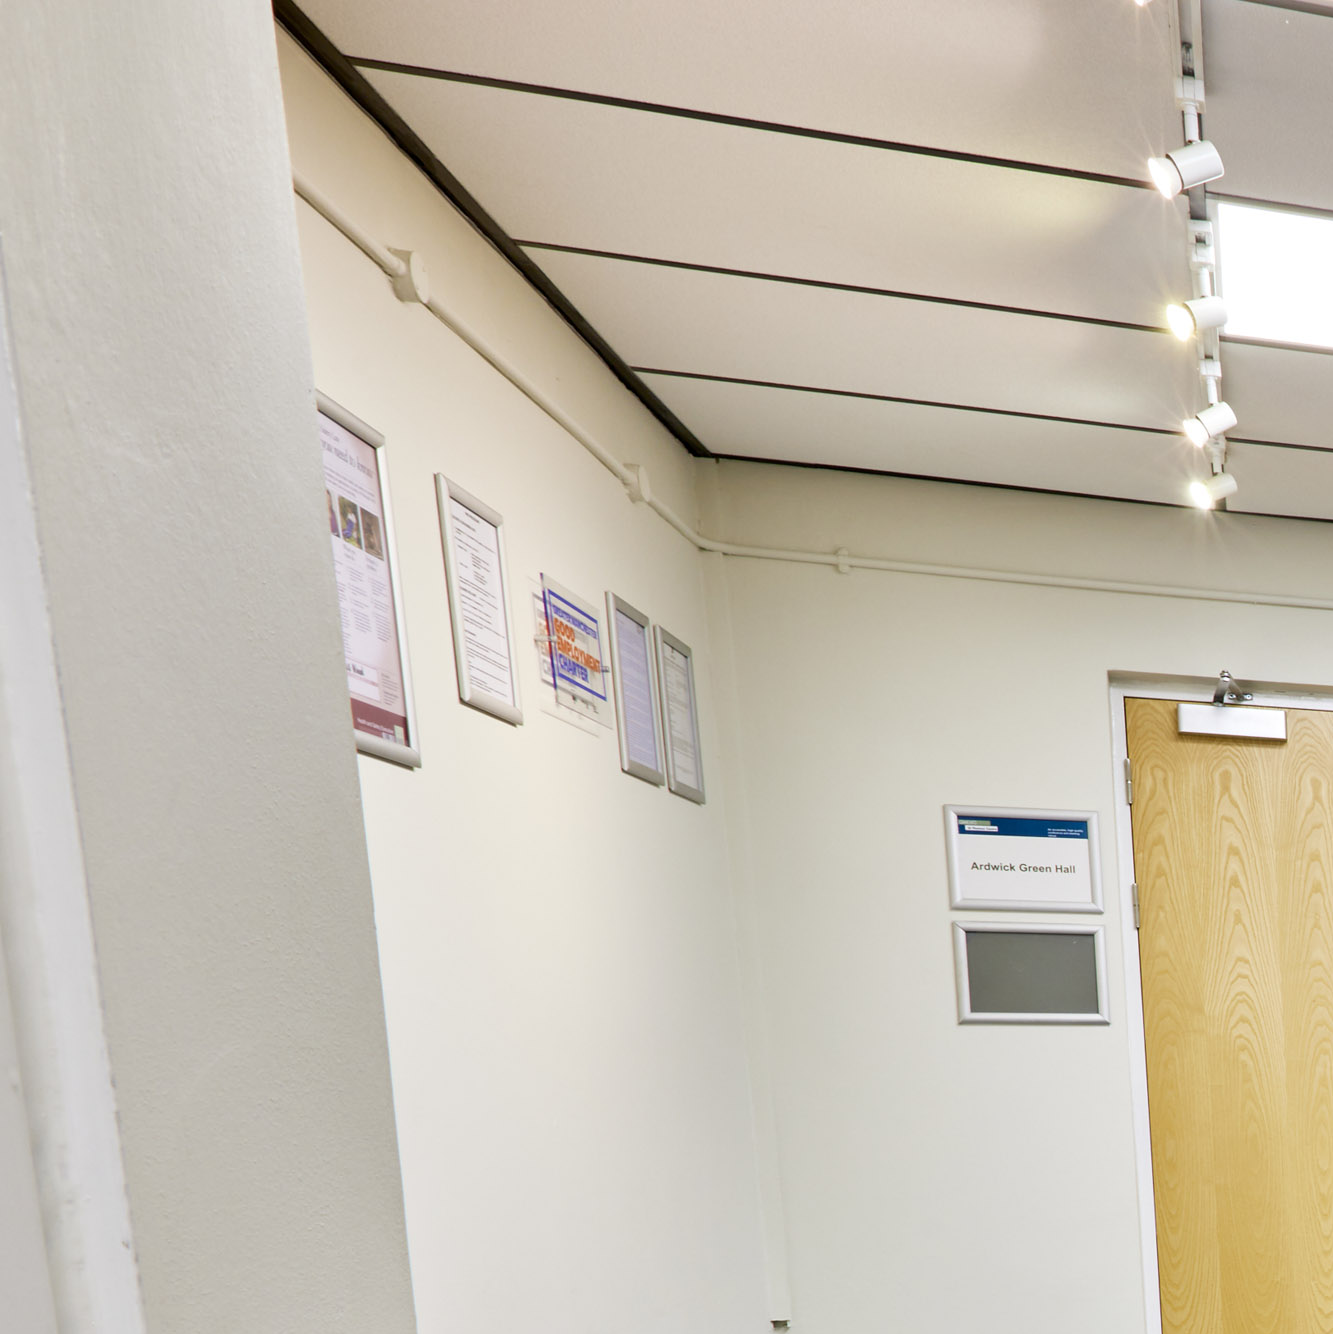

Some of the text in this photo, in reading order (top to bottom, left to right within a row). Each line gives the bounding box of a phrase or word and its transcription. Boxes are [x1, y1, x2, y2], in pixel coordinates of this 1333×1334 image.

[553, 617, 576, 643] GOOD
[556, 637, 601, 675] EMPLOYMENT
[558, 653, 589, 683] CHARTER
[971, 862, 1076, 874] Ardwick Green Hall
